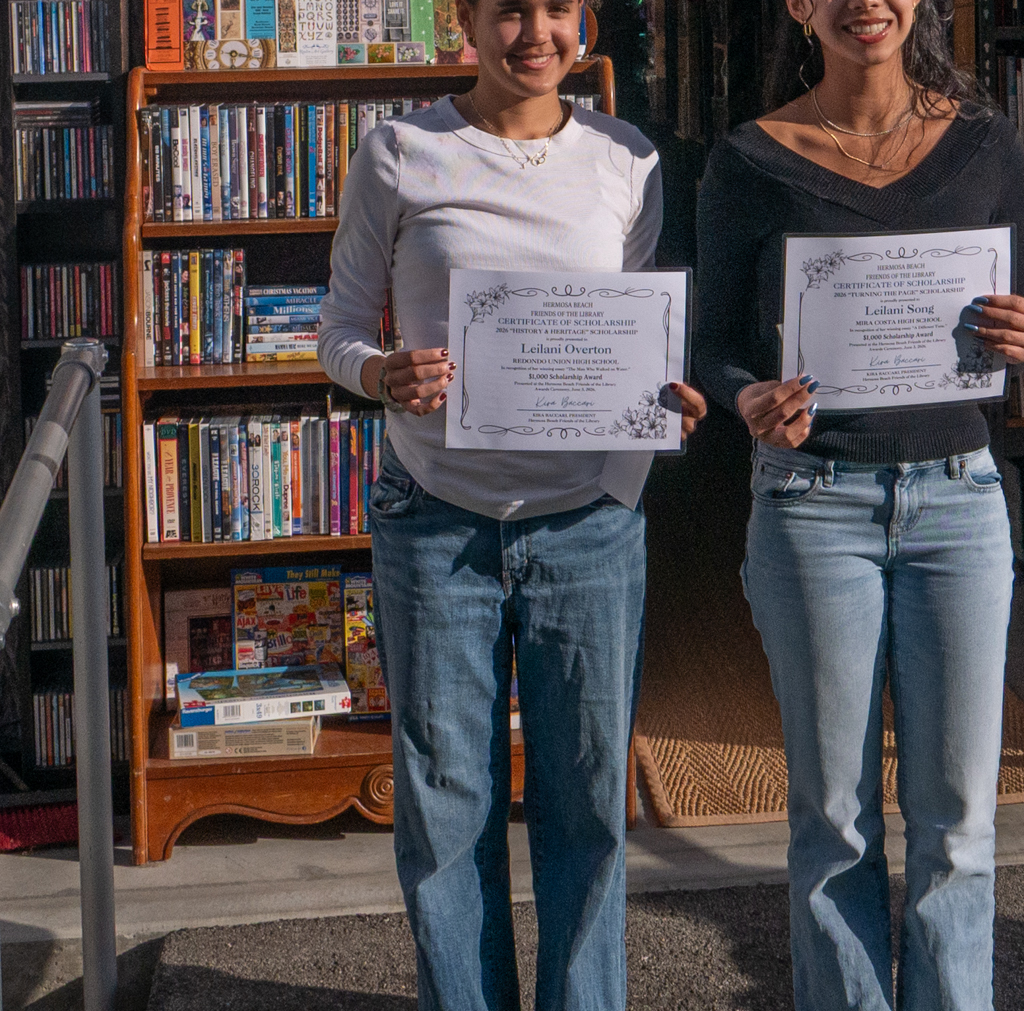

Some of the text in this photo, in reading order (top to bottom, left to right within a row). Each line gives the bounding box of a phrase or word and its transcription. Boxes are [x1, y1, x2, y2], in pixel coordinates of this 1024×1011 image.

[833, 281, 892, 289] CERTIFICATE
[906, 278, 966, 287] SCHOLARSHIP
[919, 287, 965, 295] SCHOLARSHIP
[273, 306, 313, 314] Millions
[865, 303, 935, 316] Leilani Song
[498, 317, 558, 326] CERTIFICATE
[574, 319, 636, 327] SCHOLARSHIP
[521, 343, 612, 354] Leilani Overton
[870, 355, 926, 367] Kira Baccari
[535, 396, 594, 408] Kira Baccari
[165, 459, 173, 474] YEAR
[165, 483, 175, 514] PROVENCE
[286, 570, 303, 580] They
[305, 569, 320, 578] Still
[286, 585, 307, 601] Life
[237, 617, 256, 628] AJAX
